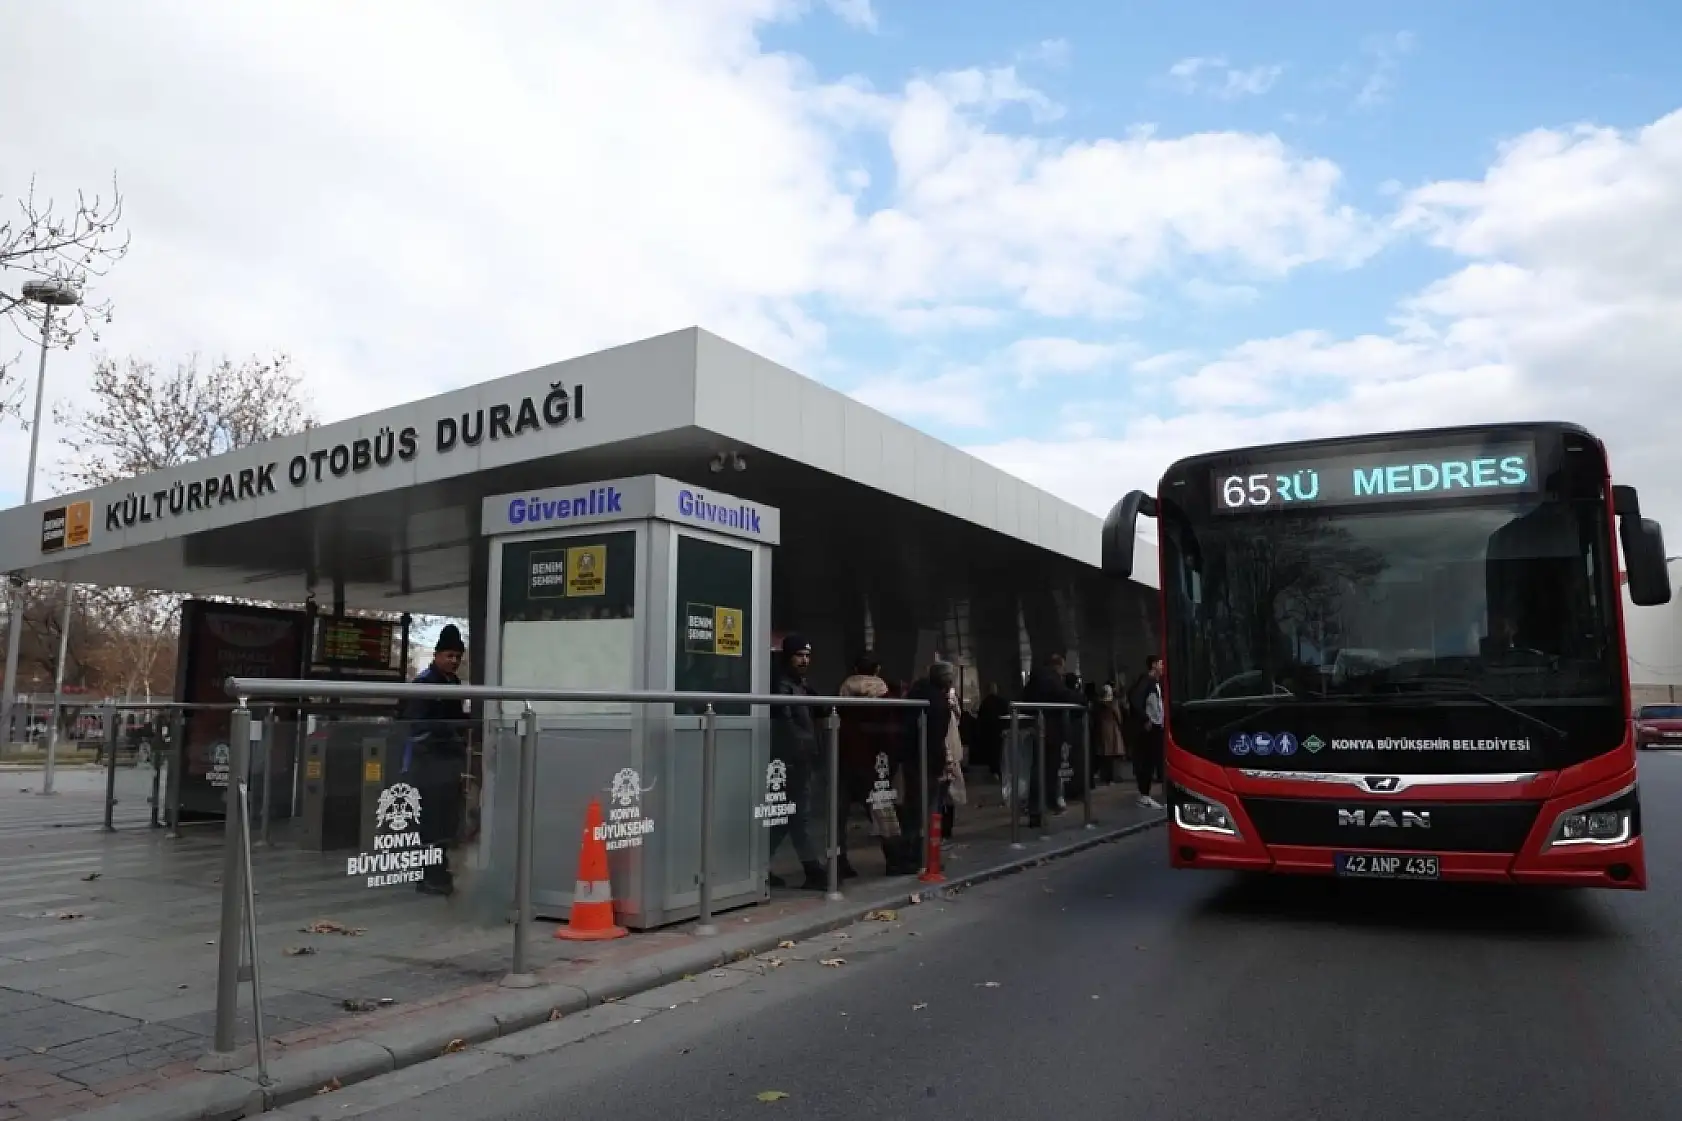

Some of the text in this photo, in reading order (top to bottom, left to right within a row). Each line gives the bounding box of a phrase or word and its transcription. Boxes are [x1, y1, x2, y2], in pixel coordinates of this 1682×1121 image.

[105, 381, 585, 532] KÜLTÜRPARK OTOBÜS DURAĞI
[1352, 455, 1528, 496] MEDRES
[1223, 473, 1271, 508] 65
[508, 486, 622, 524] Güvenlik
[678, 489, 761, 534] Güvenlik
[1331, 739, 1374, 750] KONYA
[1377, 737, 1450, 752] BÜYÜKŞEHİR
[1453, 737, 1531, 750] BELEDİYESİ
[609, 806, 640, 820] KONYA
[1338, 809, 1431, 828] MAN
[593, 816, 655, 840] BÜYÜKŞEHİR
[374, 832, 421, 850] KONYA
[347, 845, 443, 875] BÜYÜKŞEHİR
[1346, 856, 1437, 875] 42 ANP 435
[367, 868, 425, 887] BELEDİYESİ
